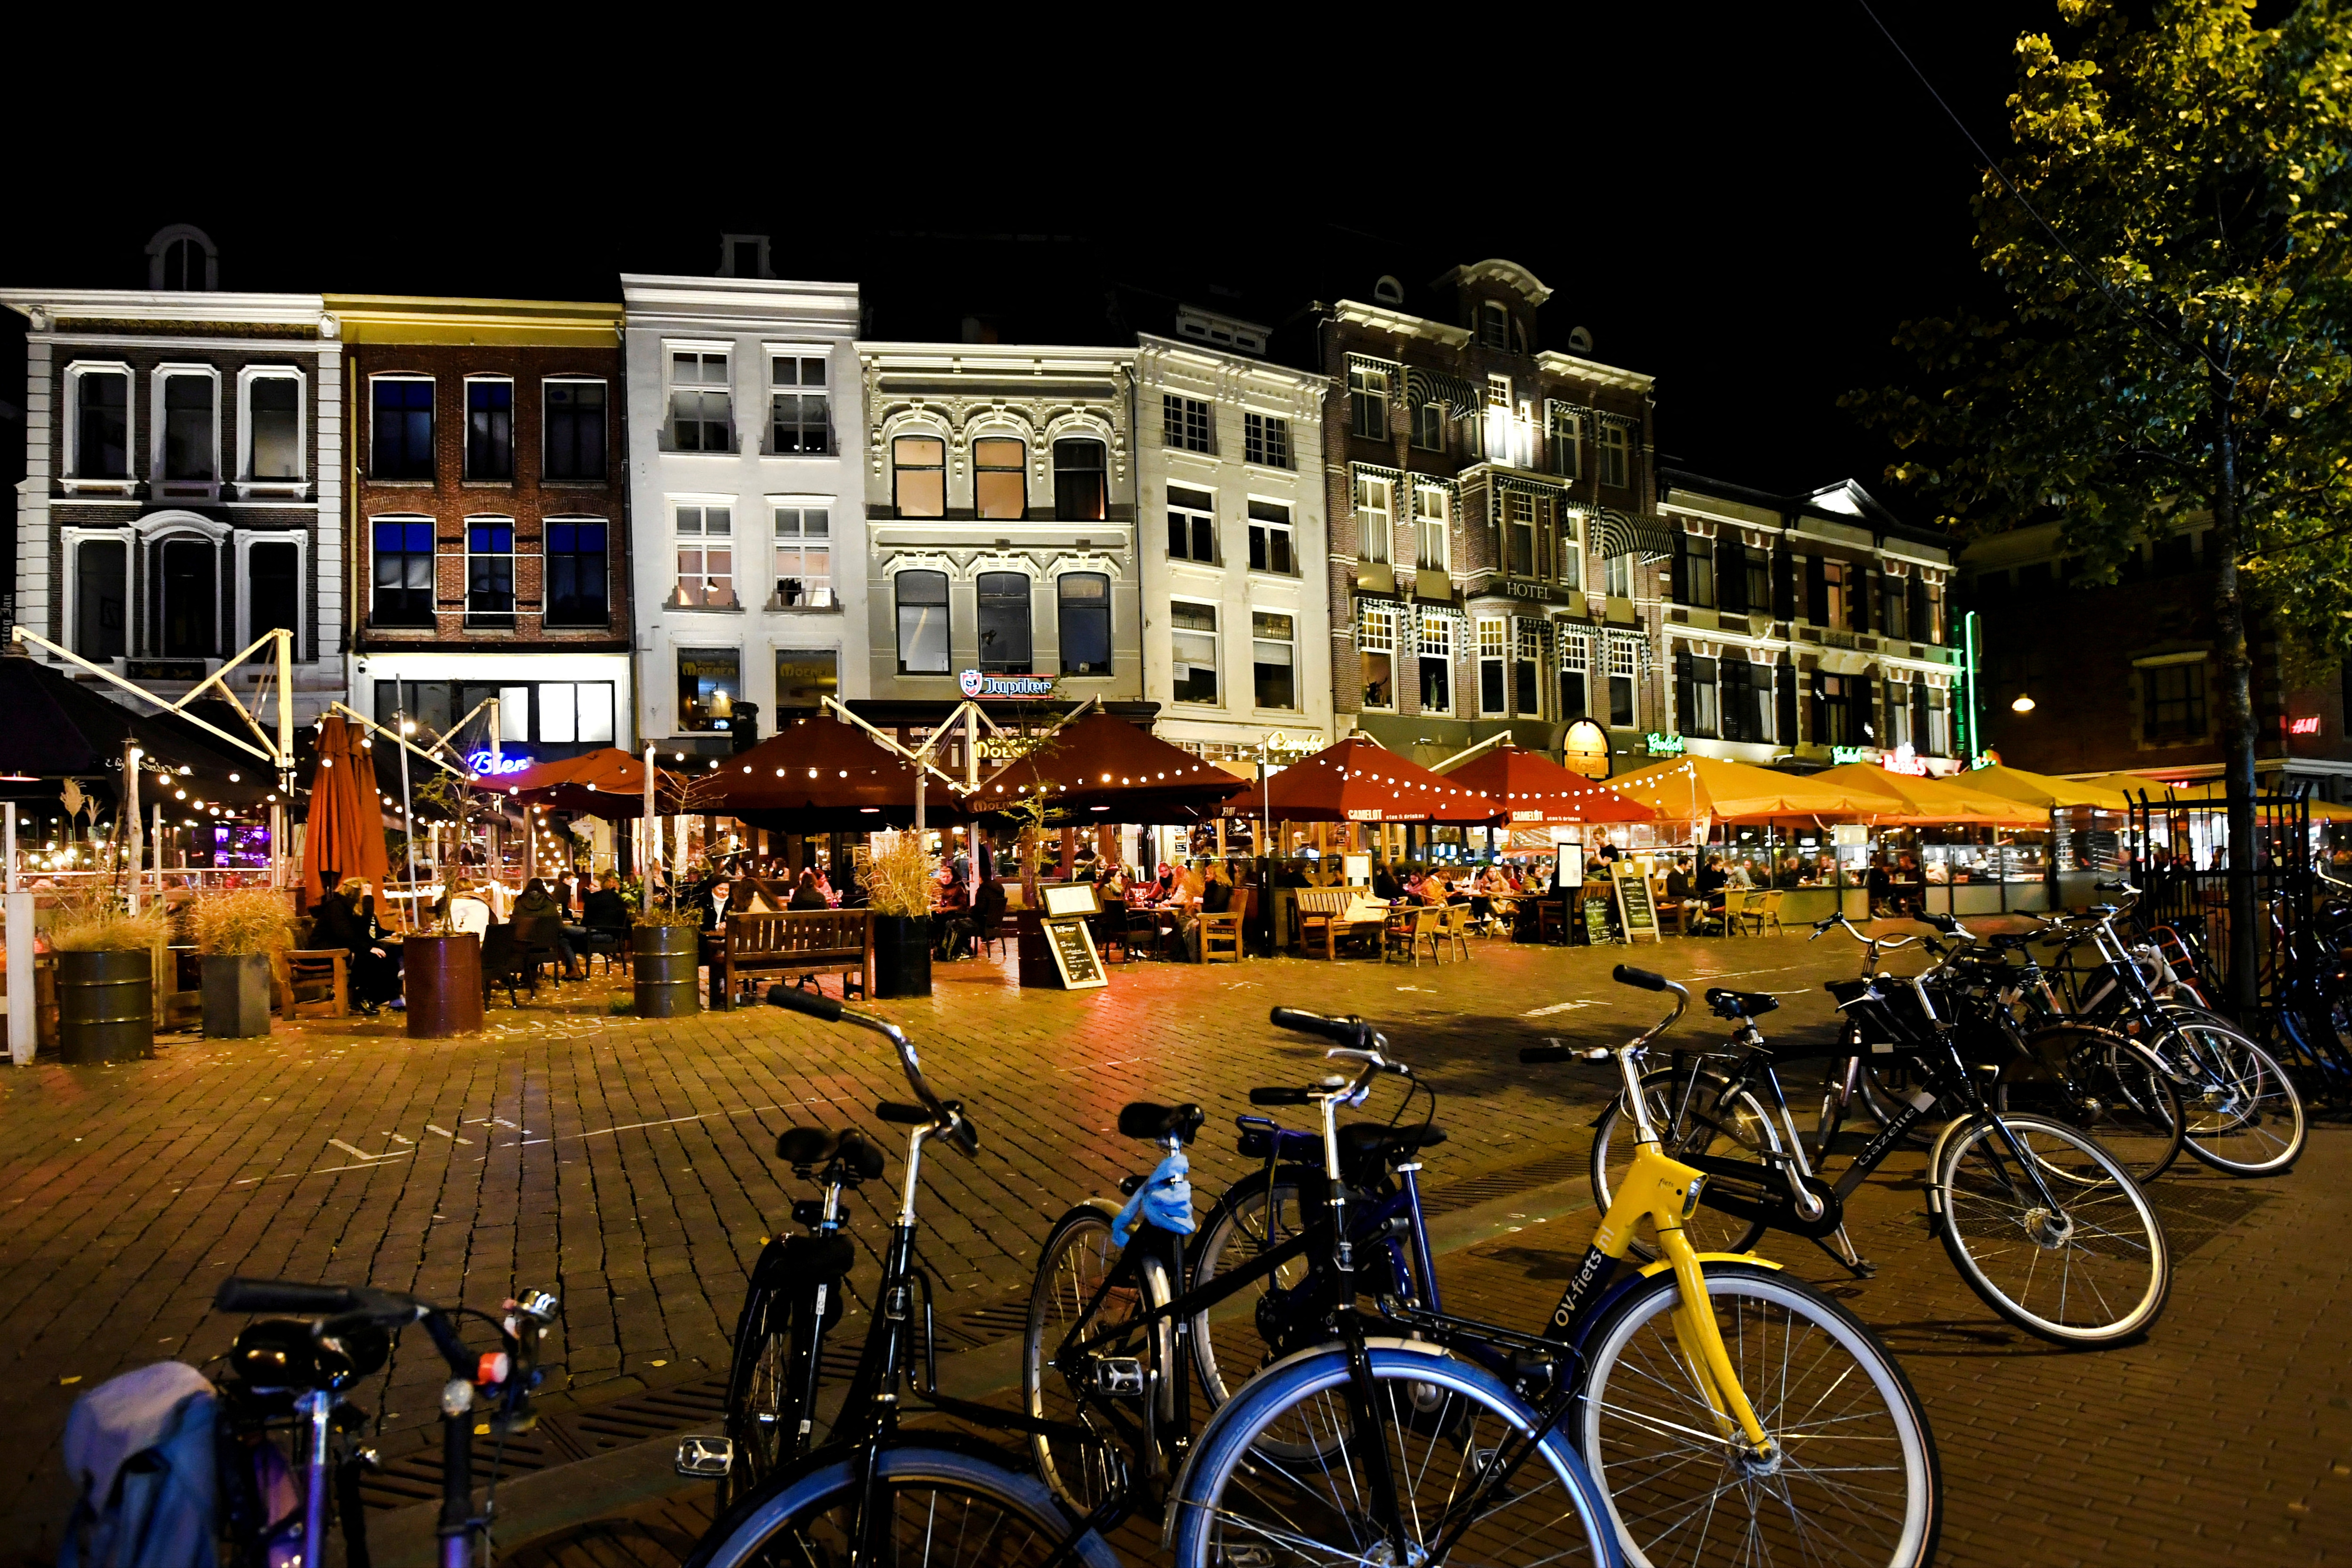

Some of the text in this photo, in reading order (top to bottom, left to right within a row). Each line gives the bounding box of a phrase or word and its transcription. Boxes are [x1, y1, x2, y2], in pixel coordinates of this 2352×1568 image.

[1506, 581, 1552, 600] HOTEL
[0, 594, 13, 618] Jan
[984, 678, 1051, 696] Jupiler
[1268, 730, 1325, 751] Camelot
[1647, 732, 1683, 753] Grolsch
[1348, 809, 1383, 820] CAMELOT
[1512, 811, 1543, 821] CAMELOT
[1858, 1108, 1915, 1166] Gazelle
[1555, 1226, 1615, 1327] OV-fiets.nl
